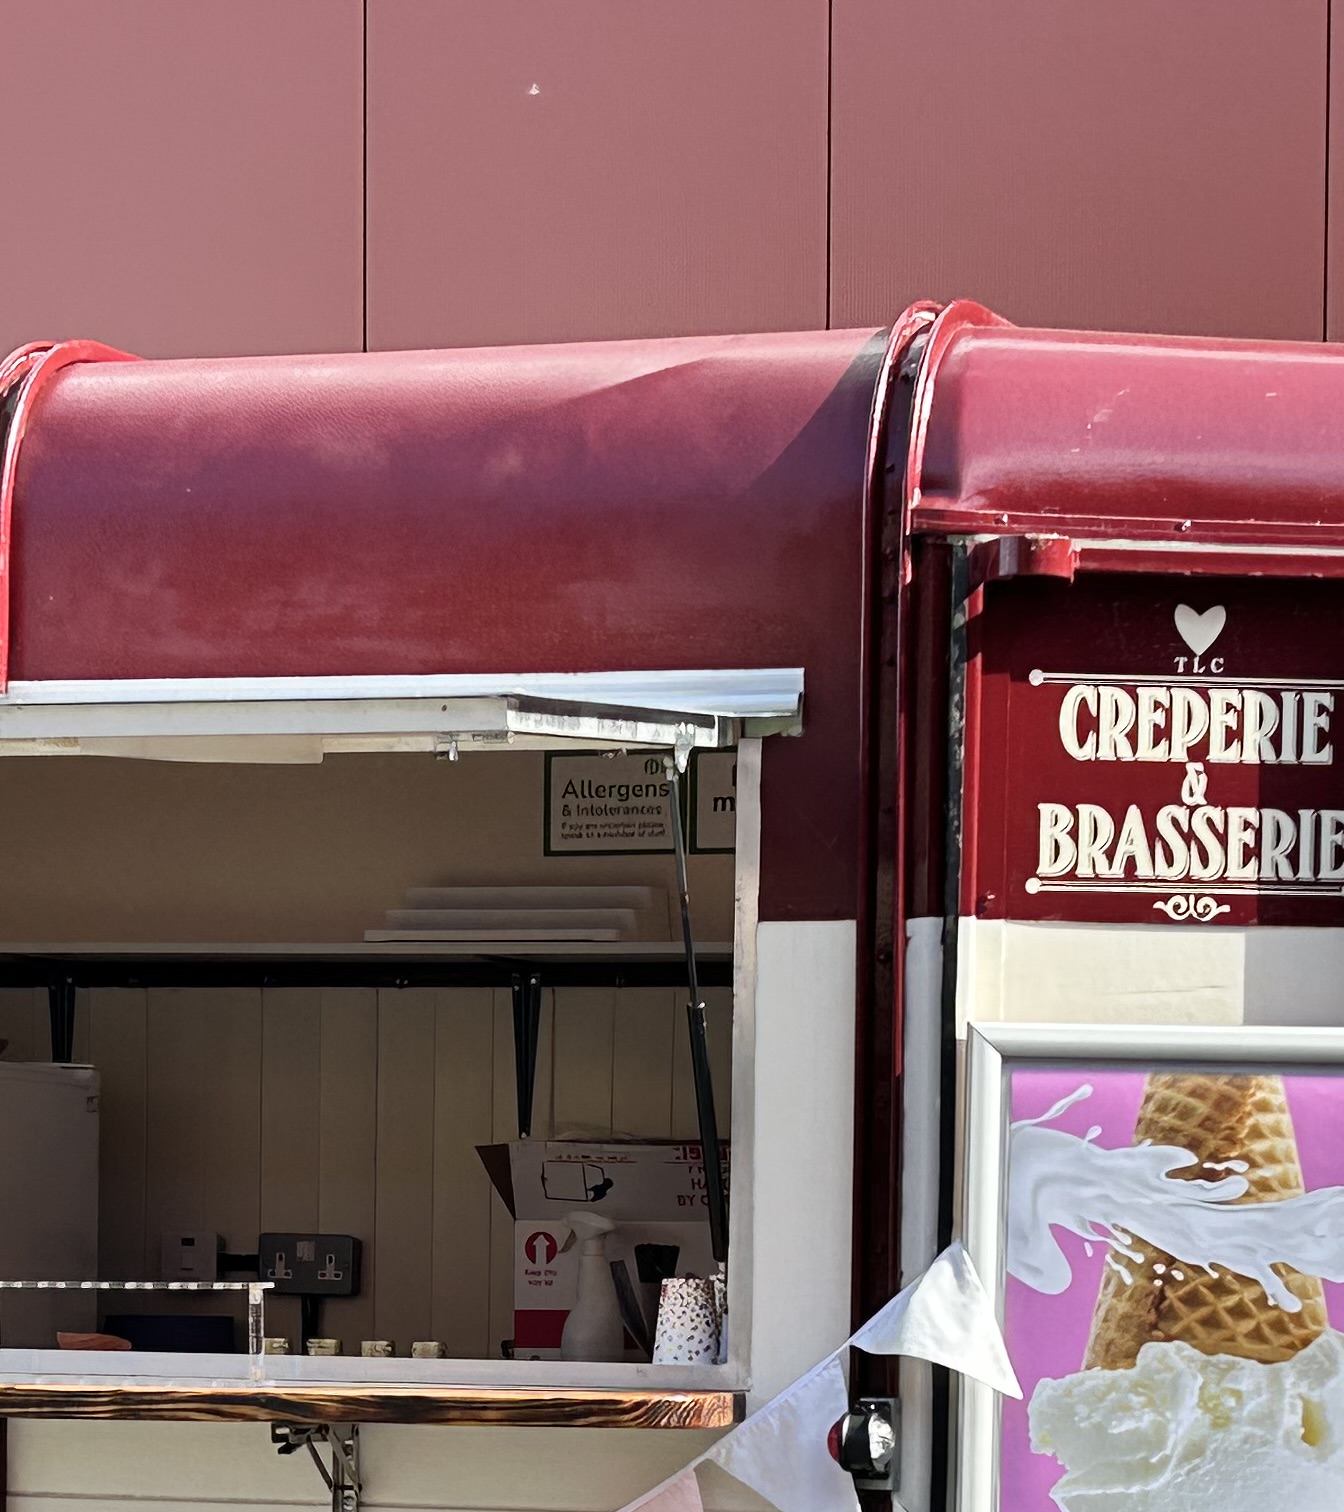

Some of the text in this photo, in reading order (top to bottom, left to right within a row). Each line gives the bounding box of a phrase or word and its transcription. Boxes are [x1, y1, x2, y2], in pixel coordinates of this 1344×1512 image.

[1173, 656, 1225, 674] TLC
[1058, 685, 1335, 767] CREPERIE
[561, 779, 670, 802] Allergens
[1180, 762, 1209, 806] &
